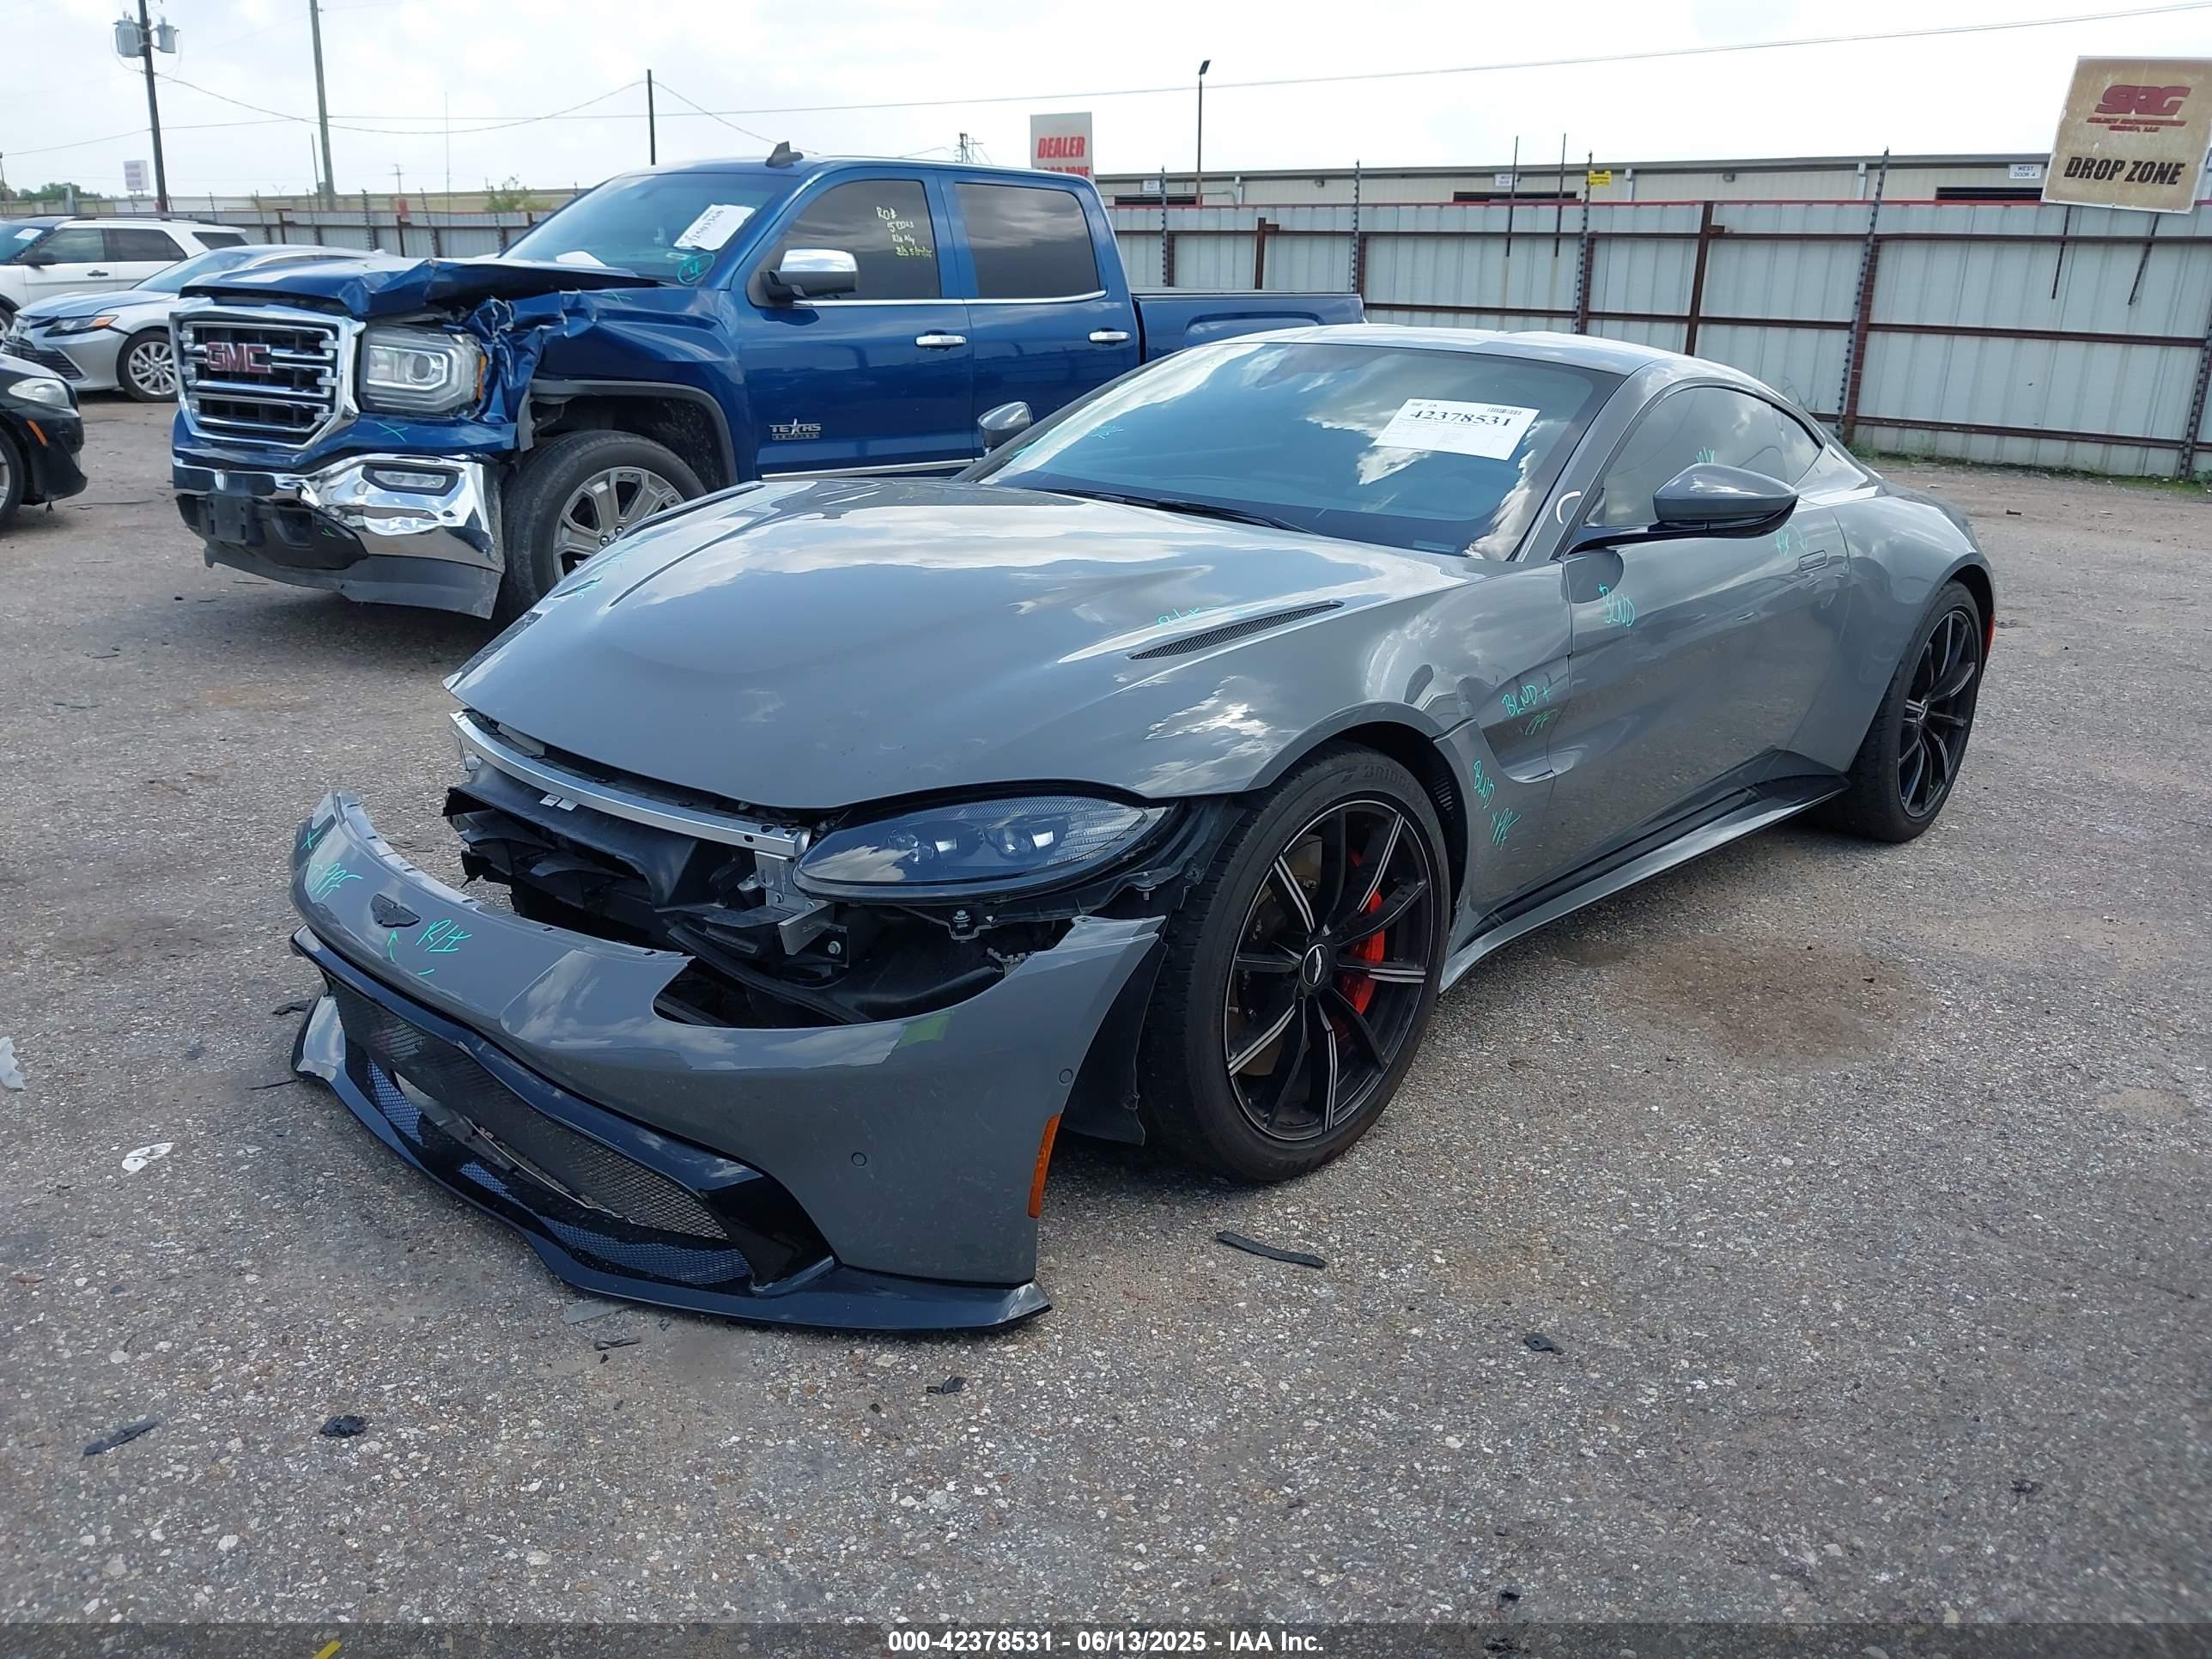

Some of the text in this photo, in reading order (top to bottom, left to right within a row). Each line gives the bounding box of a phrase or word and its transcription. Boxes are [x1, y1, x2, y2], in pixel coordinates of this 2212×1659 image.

[2094, 85, 2191, 116] SRG
[1036, 136, 1085, 159] DEALER
[2063, 156, 2186, 185] DROP ZONE
[206, 342, 272, 374] GMC
[769, 420, 822, 434] TEXAS
[1410, 410, 1511, 427] 42378531
